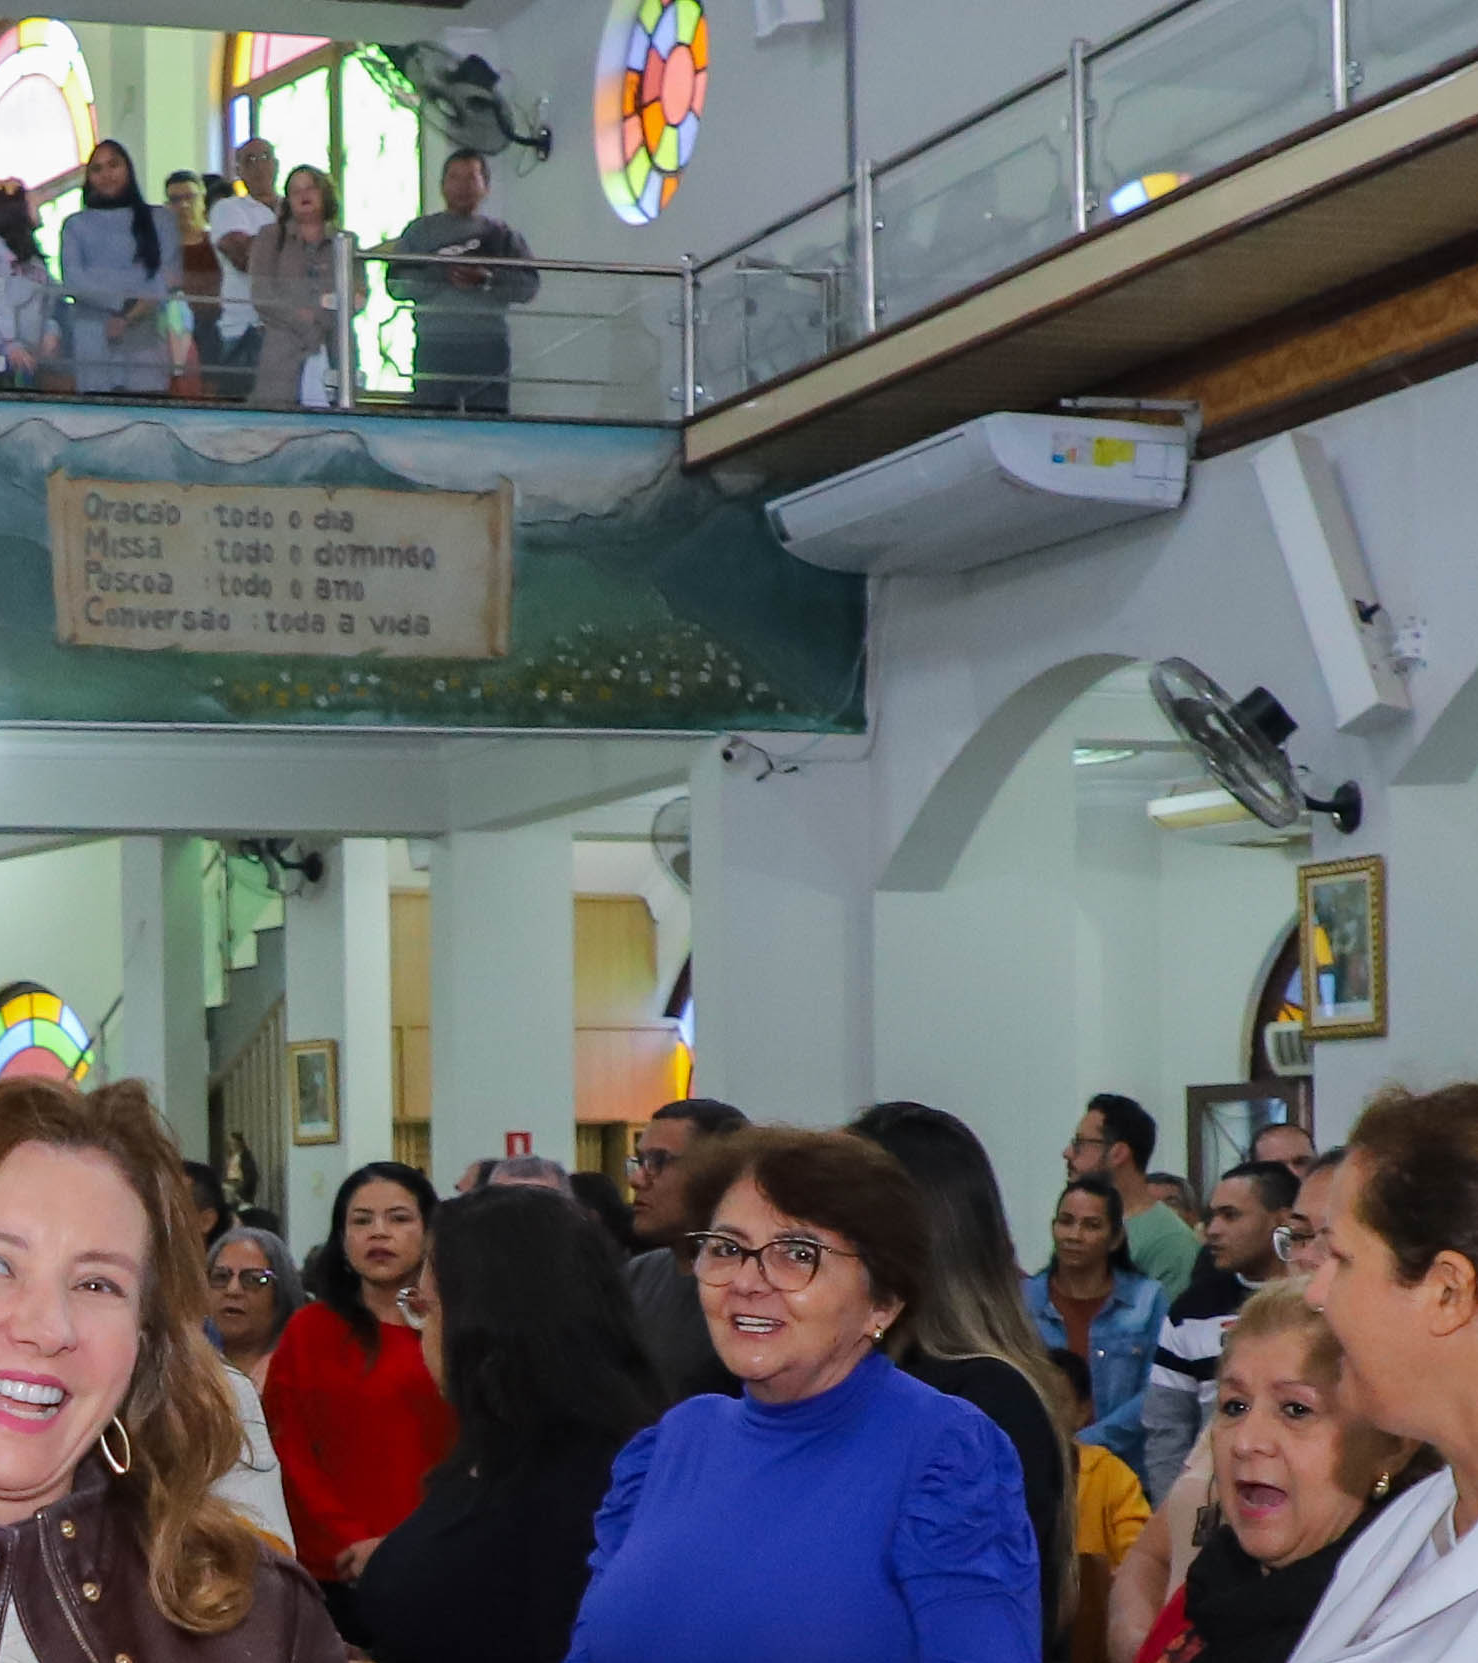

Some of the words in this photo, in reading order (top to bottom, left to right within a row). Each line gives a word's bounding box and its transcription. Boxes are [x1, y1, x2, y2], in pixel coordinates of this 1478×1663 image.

[289, 510, 302, 529] o
[314, 507, 354, 533] dia
[85, 527, 163, 560] Missa
[290, 544, 302, 566] o
[314, 540, 436, 571] domingo
[290, 578, 302, 600] o
[315, 576, 364, 602] ano
[339, 613, 355, 635] a
[369, 613, 431, 637] vida
